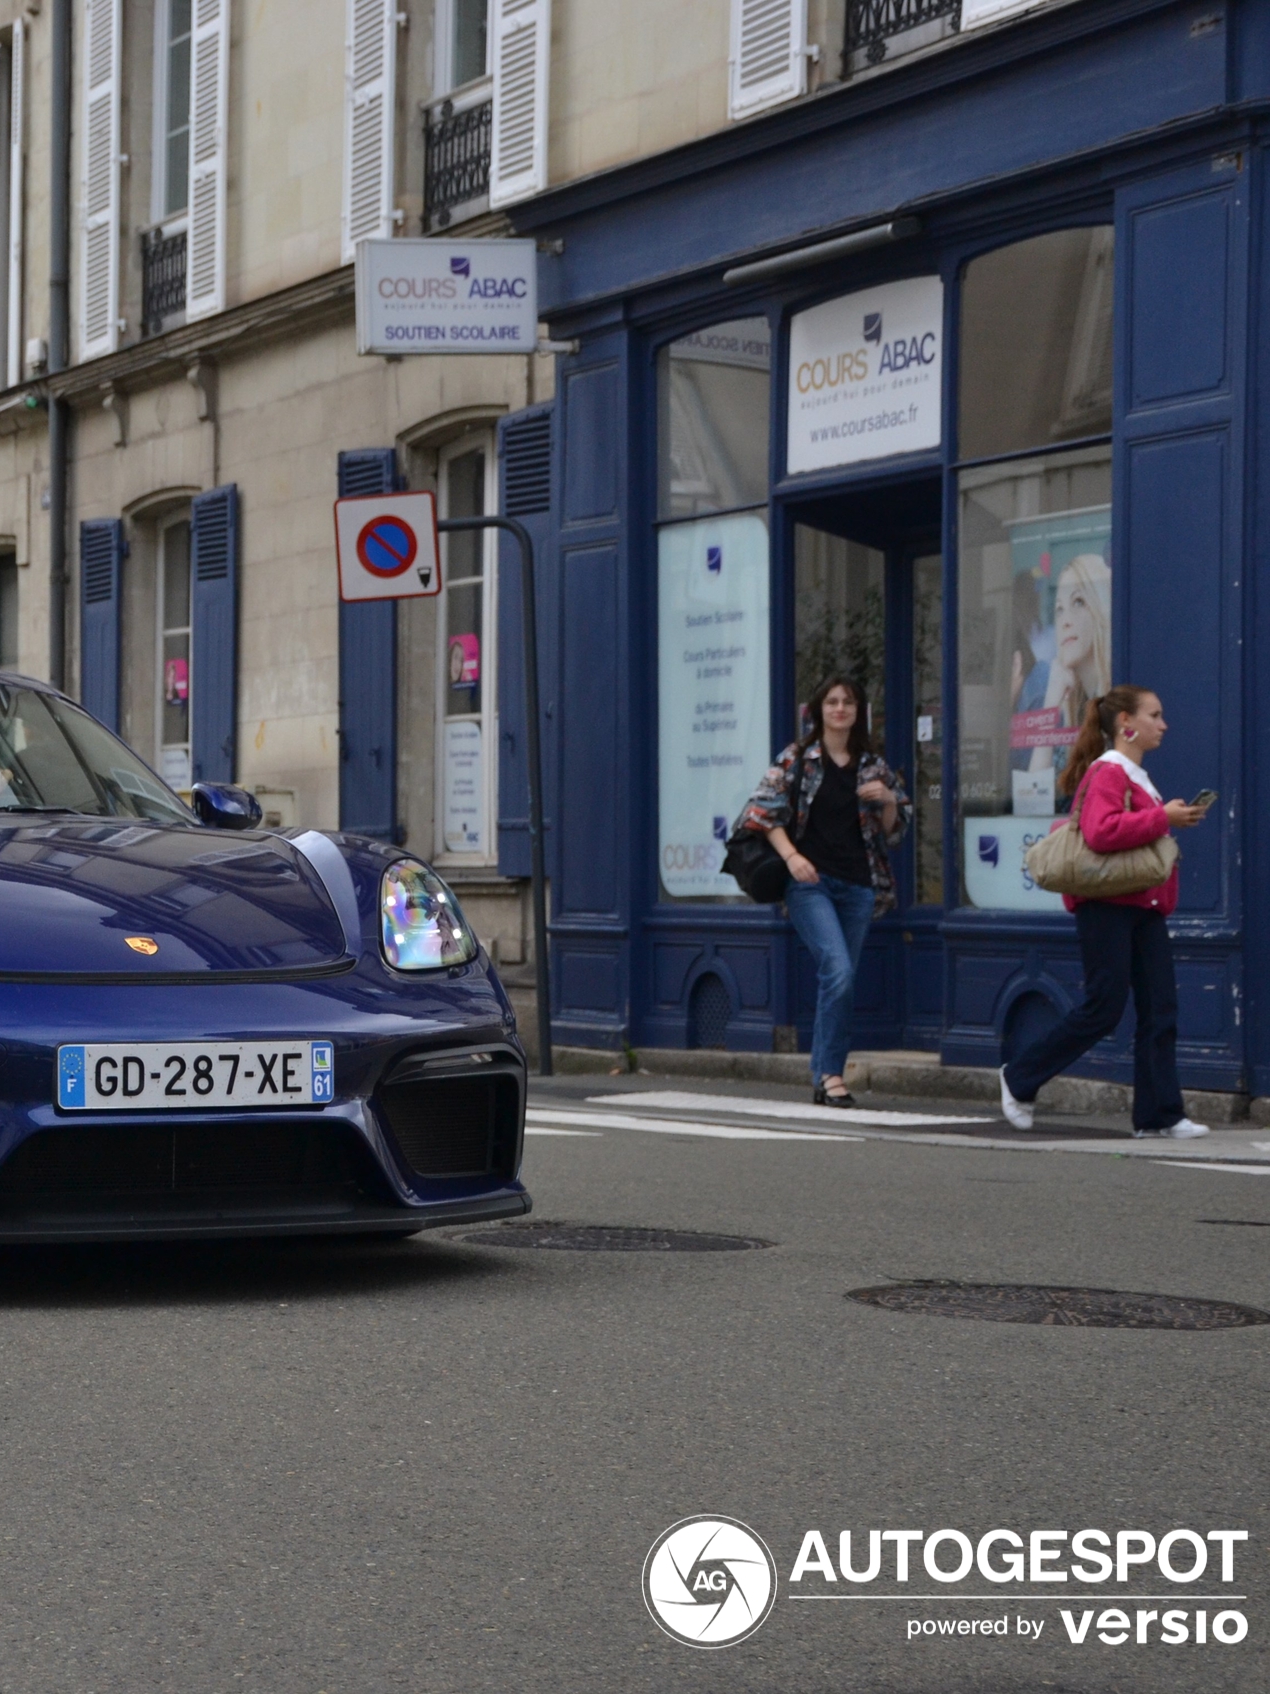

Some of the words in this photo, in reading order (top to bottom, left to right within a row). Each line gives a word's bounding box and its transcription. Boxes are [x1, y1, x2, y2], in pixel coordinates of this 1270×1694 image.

[379, 277, 456, 299] COURS
[469, 278, 527, 299] ABAC
[385, 326, 446, 340] SOUTIEN
[450, 326, 520, 340] SCOLAIRE
[796, 348, 869, 394] COURS
[878, 332, 936, 376] ABAC
[863, 381, 888, 397] pour
[892, 372, 930, 389] demain
[810, 402, 919, 444] www.coursabac.fr
[663, 844, 718, 870] COURS
[66, 1078, 78, 1093] F
[94, 1053, 303, 1097] GD-287-XE
[314, 1074, 331, 1097] 61
